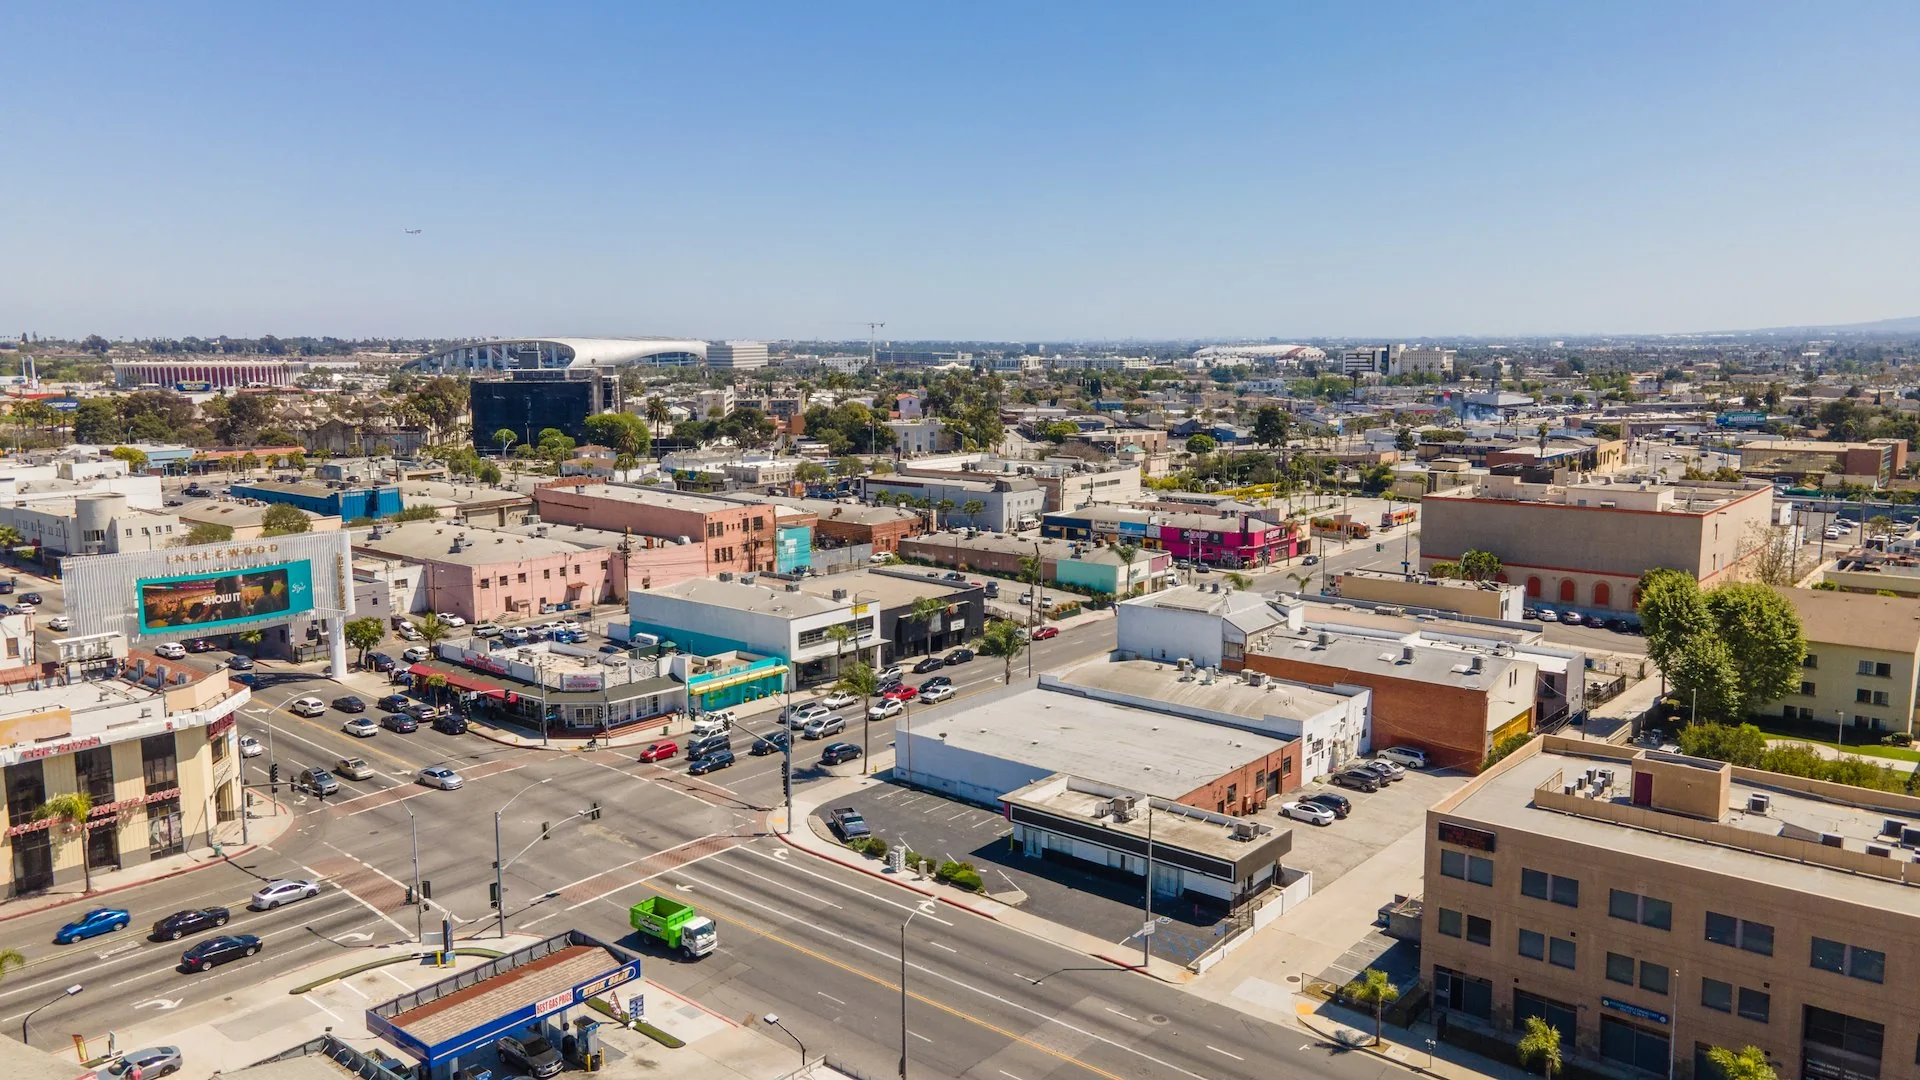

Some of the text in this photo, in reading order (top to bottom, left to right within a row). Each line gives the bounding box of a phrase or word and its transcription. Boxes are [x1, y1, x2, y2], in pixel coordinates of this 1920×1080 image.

[165, 543, 279, 565] INGLEWOOD
[202, 591, 241, 606] SHOW IT
[91, 786, 182, 817] INSURANCE
[536, 991, 572, 1014] BEST GAS PRICE
